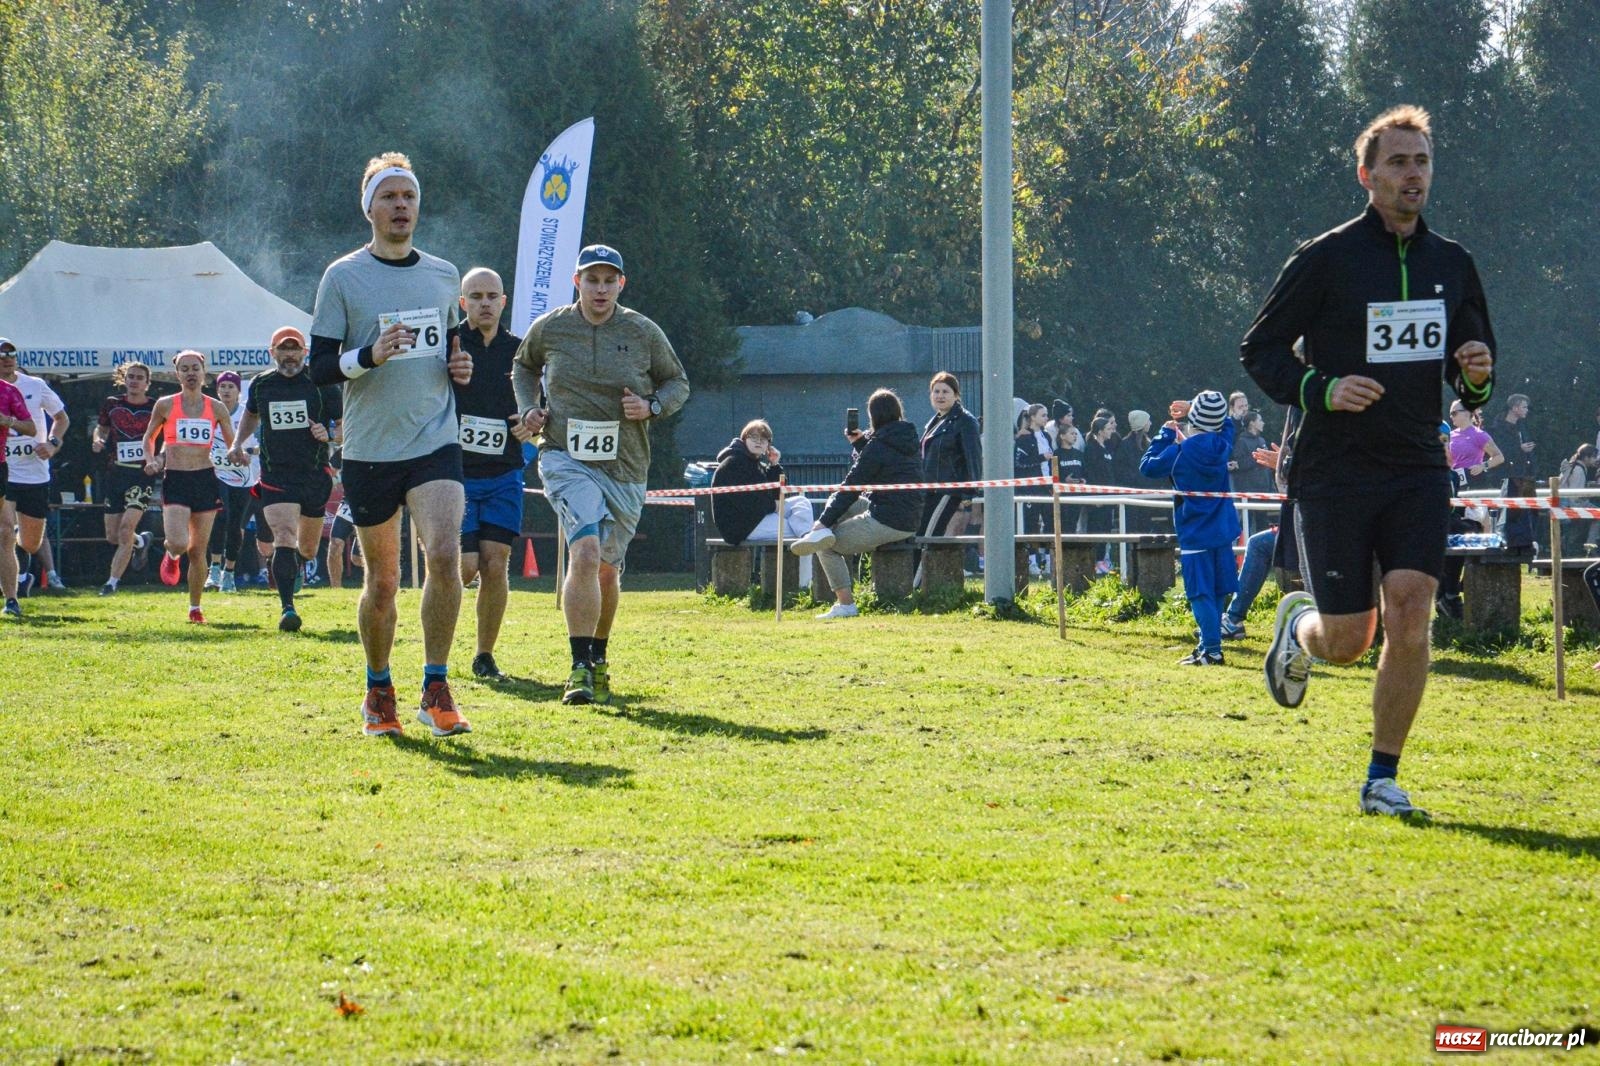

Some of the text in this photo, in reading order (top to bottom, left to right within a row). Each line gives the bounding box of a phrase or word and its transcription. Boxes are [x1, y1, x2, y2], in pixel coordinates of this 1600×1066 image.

[533, 217, 559, 289] STOWARZYSZENIE
[1373, 322, 1441, 351] 346
[112, 350, 165, 366] AKTYWNI
[211, 350, 271, 366] LEPSZEGO
[272, 411, 306, 424] 335
[179, 427, 211, 440] 196
[462, 428, 504, 448] 329
[570, 434, 614, 453] 148
[119, 448, 144, 458] 150
